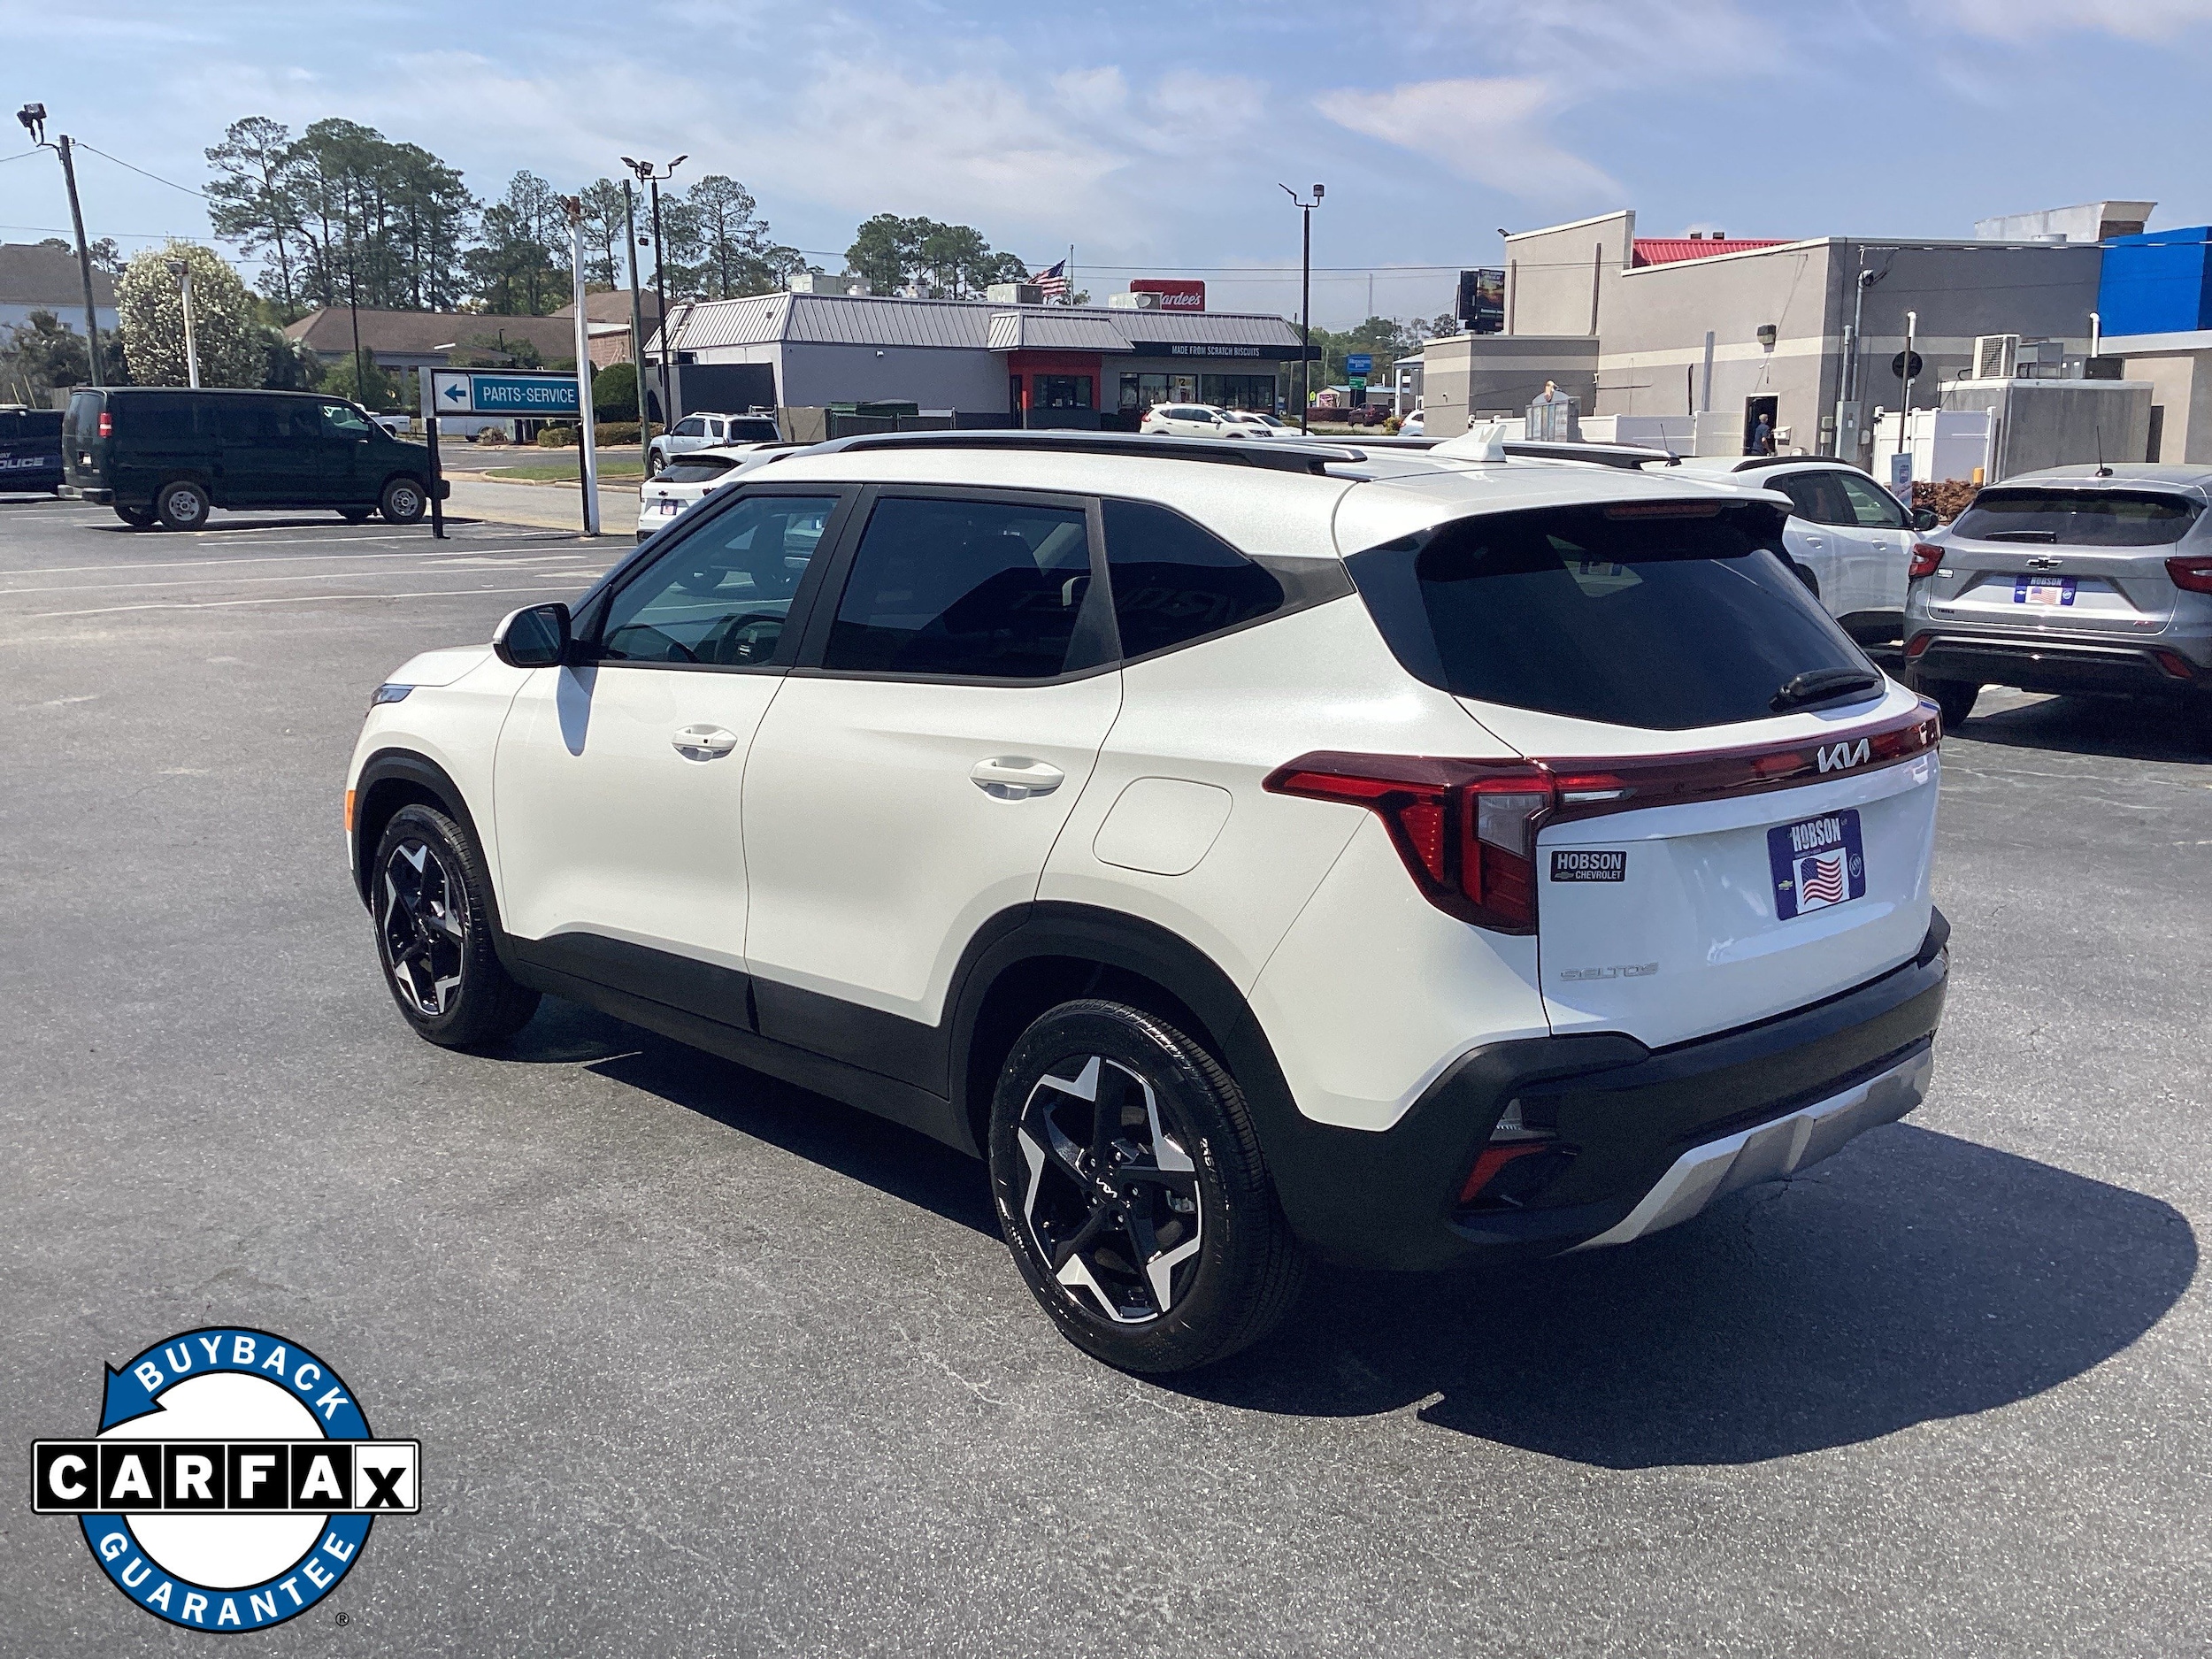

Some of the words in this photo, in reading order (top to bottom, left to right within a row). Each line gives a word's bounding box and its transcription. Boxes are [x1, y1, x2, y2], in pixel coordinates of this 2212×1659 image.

[1161, 292, 1201, 306] ardee's
[1171, 345, 1188, 355] MADE
[1189, 346, 1206, 355] FROM
[1207, 346, 1233, 356] SCRATCH
[1233, 347, 1260, 357] BISCUITS
[482, 386, 575, 403] PARTS-SERVICE
[0, 457, 45, 469] OLICE
[2031, 577, 2062, 586] HOBSON
[1792, 818, 1841, 852] HOBSON
[1557, 853, 1622, 870] HOBSON
[1575, 870, 1622, 879] CHEVROLET
[1560, 961, 1659, 981] SELTOS
